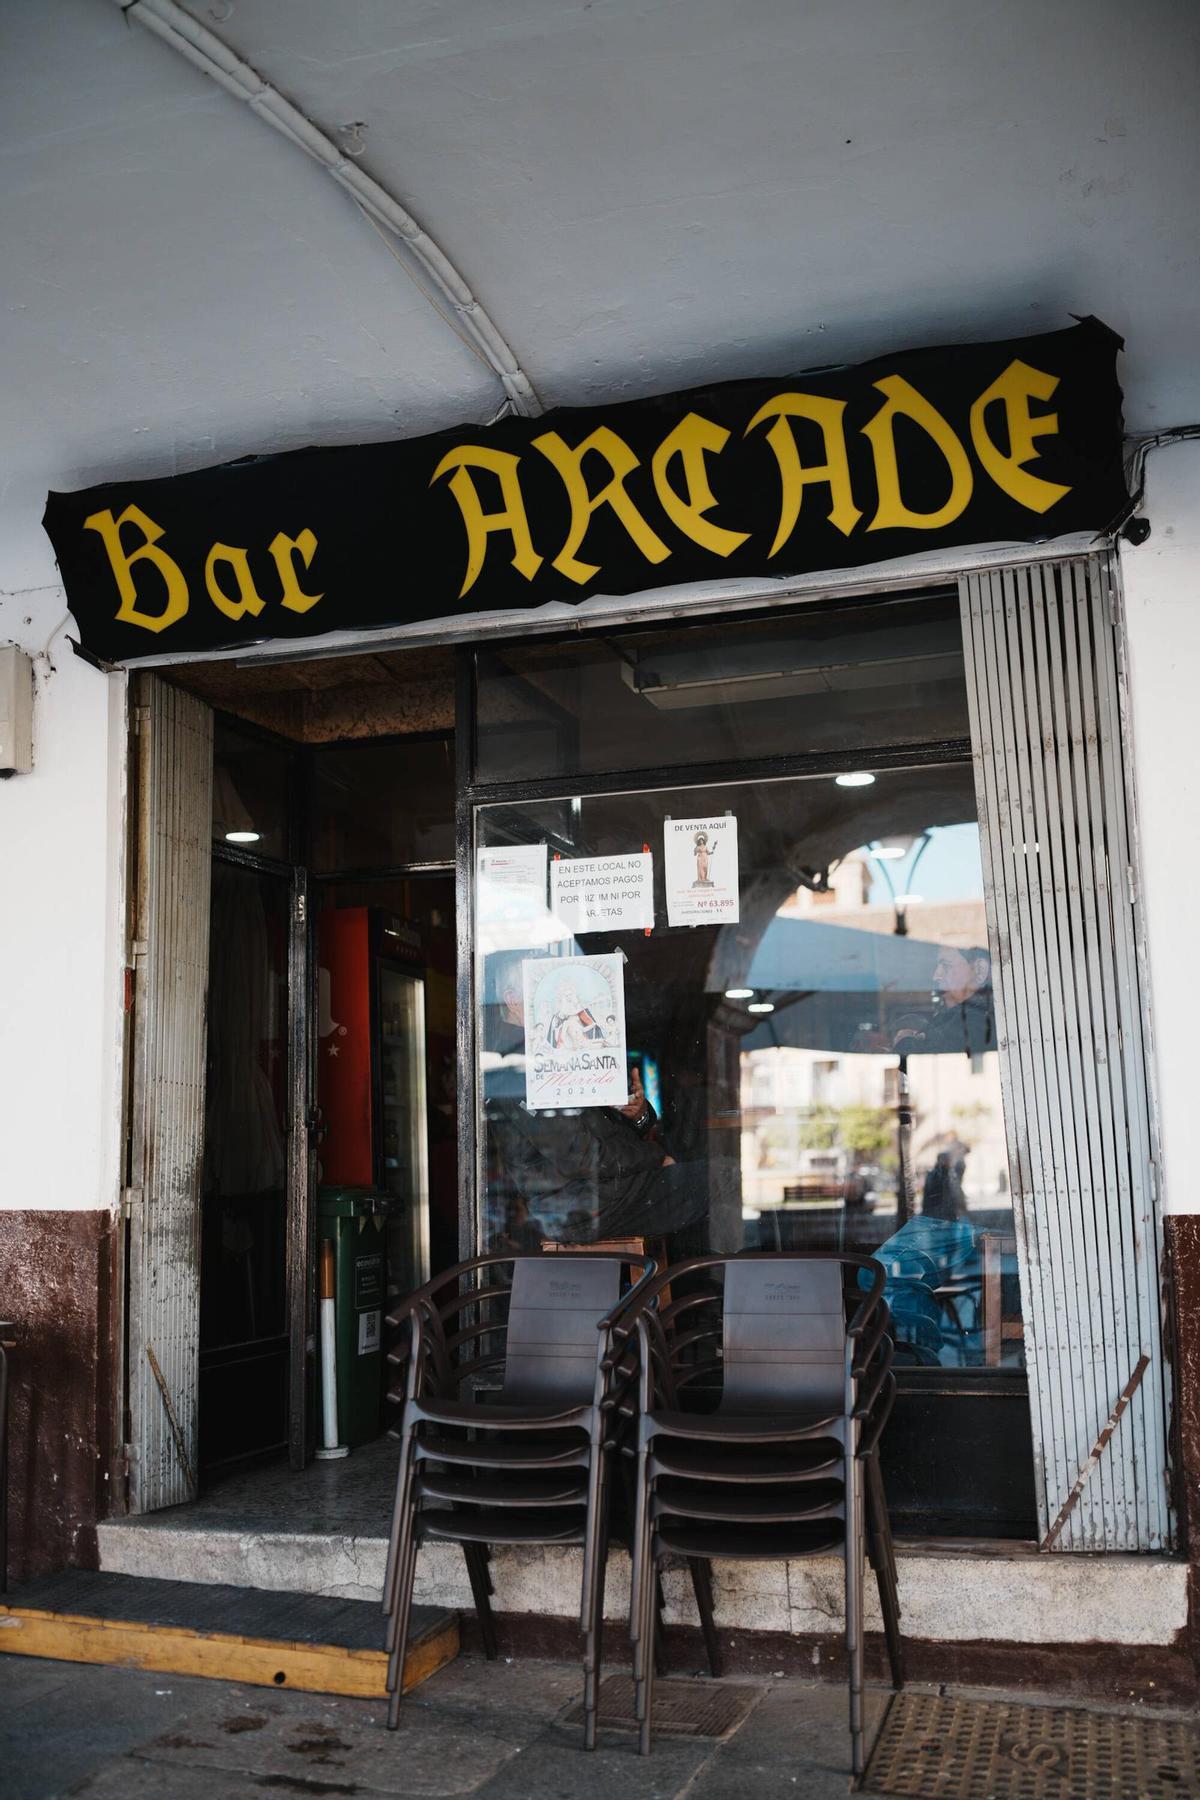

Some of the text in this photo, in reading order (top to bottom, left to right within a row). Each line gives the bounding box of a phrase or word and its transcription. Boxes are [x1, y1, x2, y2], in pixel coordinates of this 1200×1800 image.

[83, 358, 1073, 633] Bar ARCADE
[685, 823, 708, 831] VENTA
[559, 860, 641, 874] EN ESTE LOCAL NO
[557, 874, 644, 888] ACEPTAMOS PAGOS
[560, 895, 579, 904] POR
[610, 891, 620, 900] NI
[621, 890, 641, 899] POR
[709, 899, 735, 907] 63.895
[556, 1087, 597, 1096] 2026
